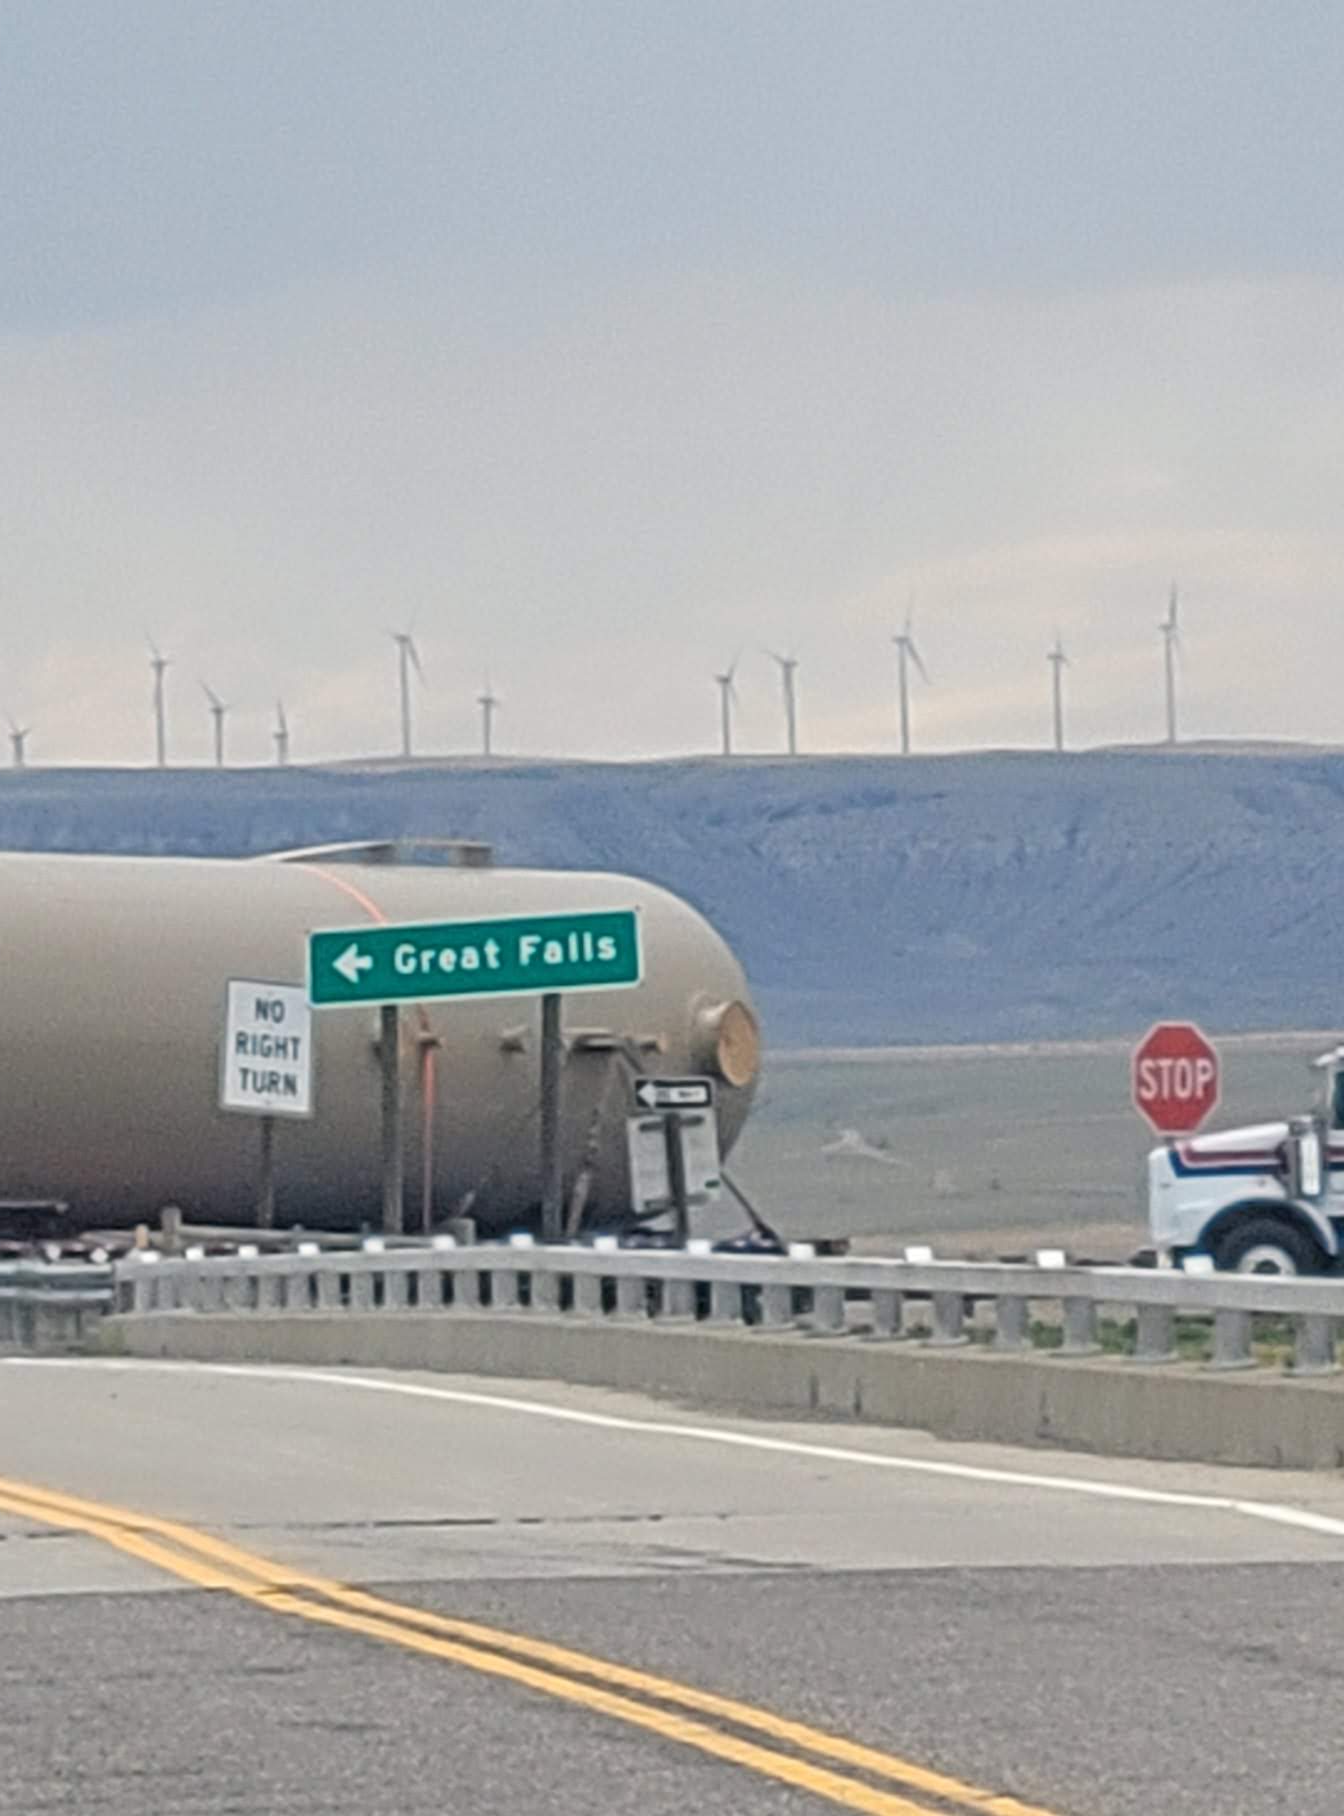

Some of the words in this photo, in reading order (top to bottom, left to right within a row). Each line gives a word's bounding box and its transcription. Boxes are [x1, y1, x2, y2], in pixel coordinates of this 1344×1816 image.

[394, 938, 500, 975] Great
[518, 931, 617, 966] Falls
[255, 998, 286, 1024] NO
[236, 1030, 301, 1061] RIGHT
[239, 1067, 298, 1096] TURN
[1139, 1058, 1214, 1100] STOP
